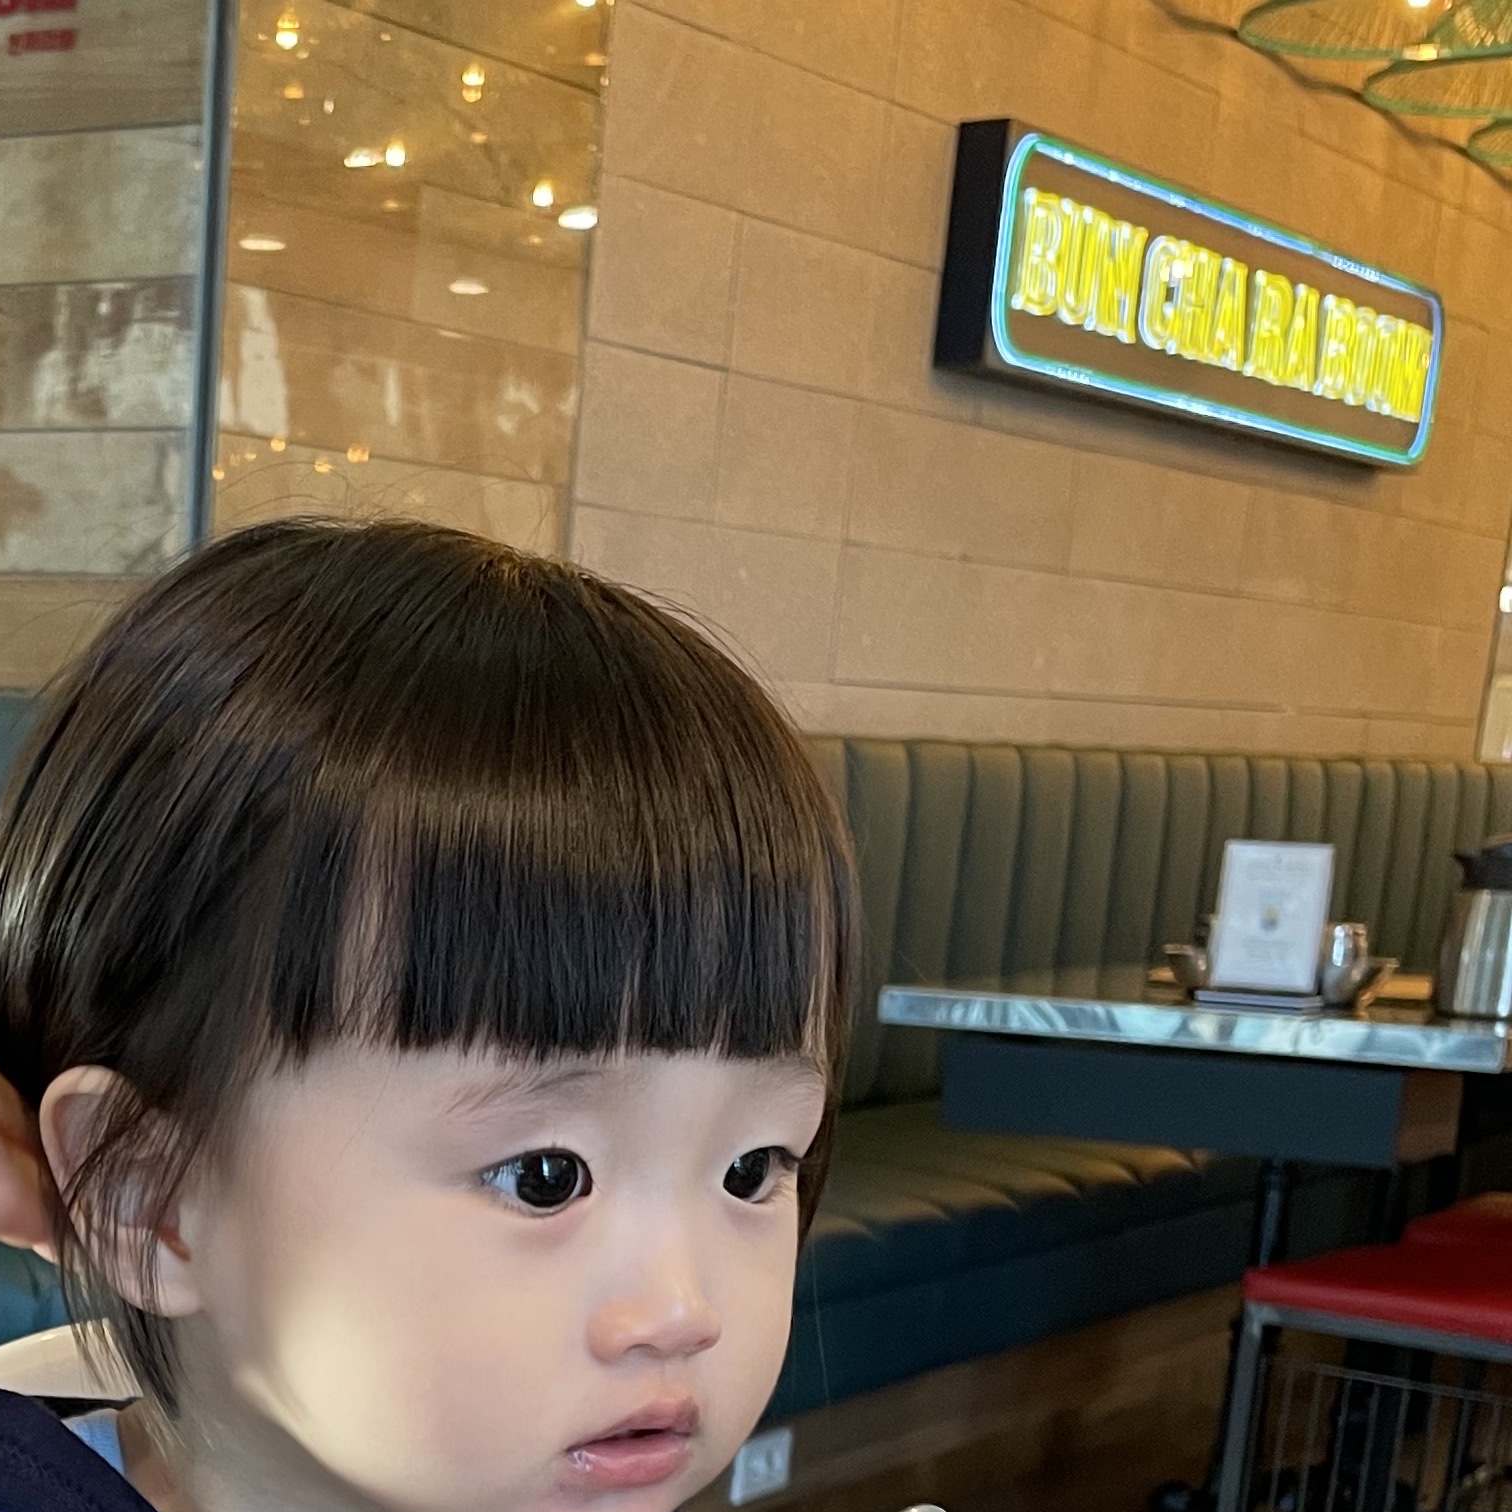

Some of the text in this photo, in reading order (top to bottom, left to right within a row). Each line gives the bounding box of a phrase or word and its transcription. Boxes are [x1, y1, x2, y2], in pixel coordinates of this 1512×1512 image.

[1010, 187, 1148, 344] BUN
[1138, 235, 1248, 373] CHA
[1243, 270, 1319, 392] RA
